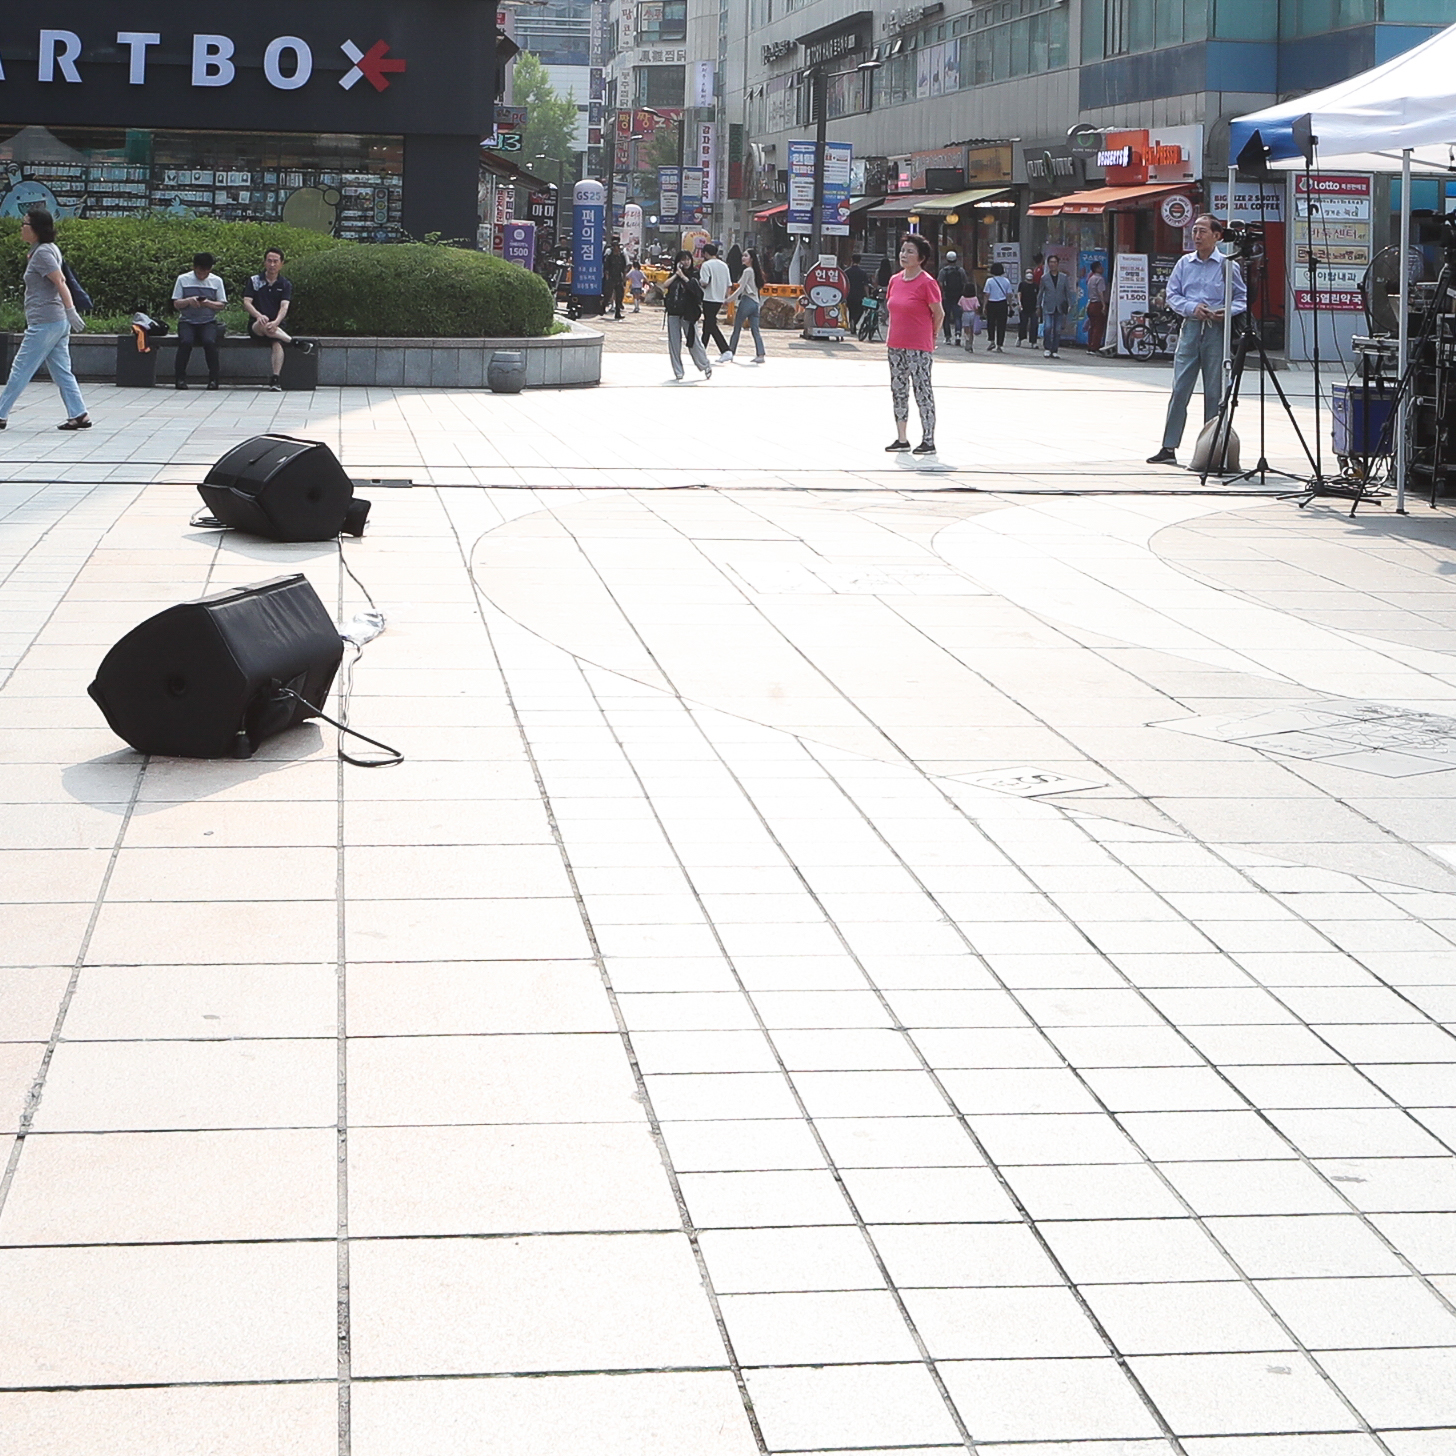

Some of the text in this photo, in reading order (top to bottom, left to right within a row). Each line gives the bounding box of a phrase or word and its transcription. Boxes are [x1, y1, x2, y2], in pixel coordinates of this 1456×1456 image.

[1313, 180, 1340, 191] Lotto
[576, 190, 602, 201] GS25
[580, 208, 596, 262] 편의점
[814, 268, 840, 284] 헌혈
